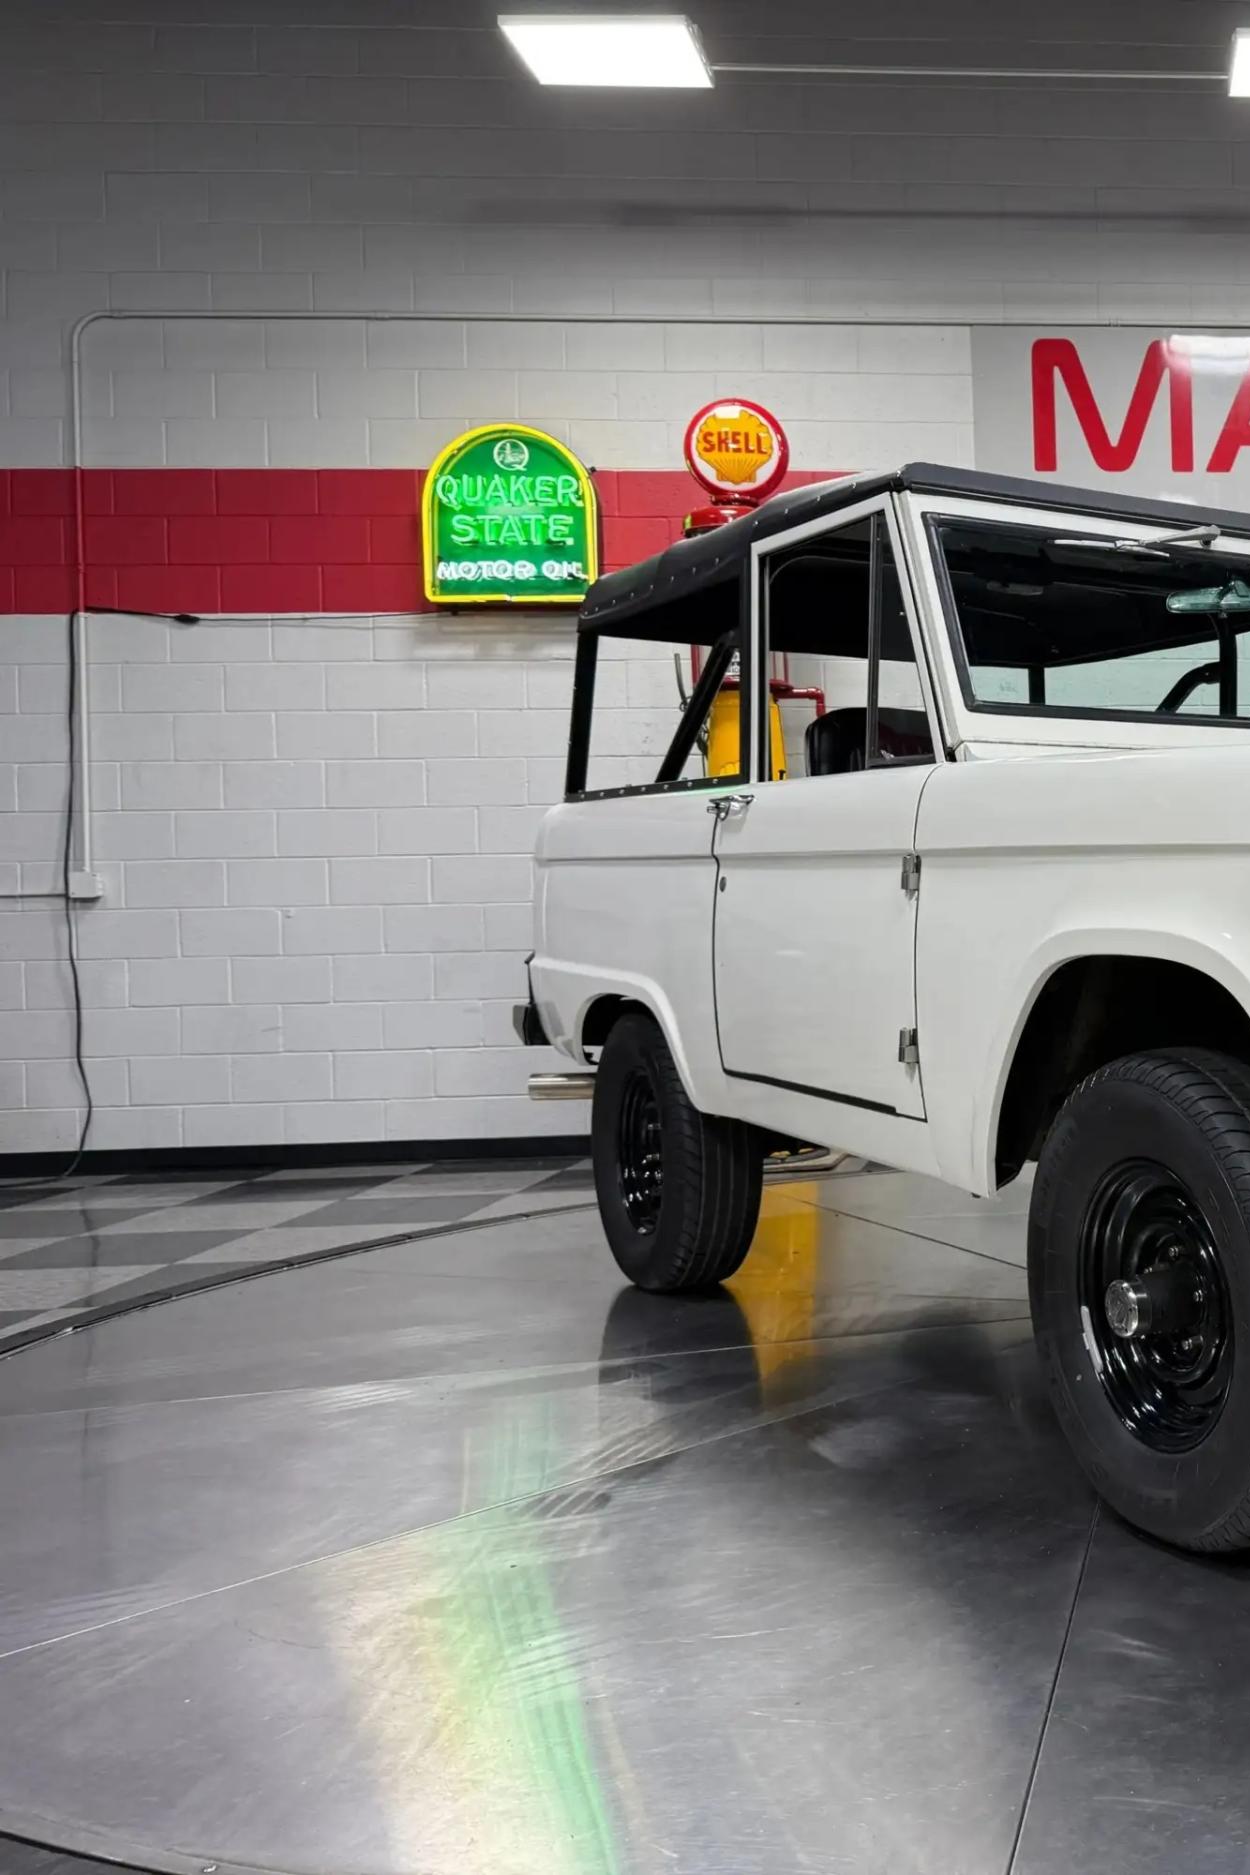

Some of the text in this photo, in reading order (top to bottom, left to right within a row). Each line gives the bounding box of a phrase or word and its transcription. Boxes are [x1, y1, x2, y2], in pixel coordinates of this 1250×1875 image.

[702, 430, 768, 455] SHELL
[435, 474, 585, 512] QUAKER
[450, 513, 575, 546] STATE
[436, 560, 589, 582] MOTOR OIL
